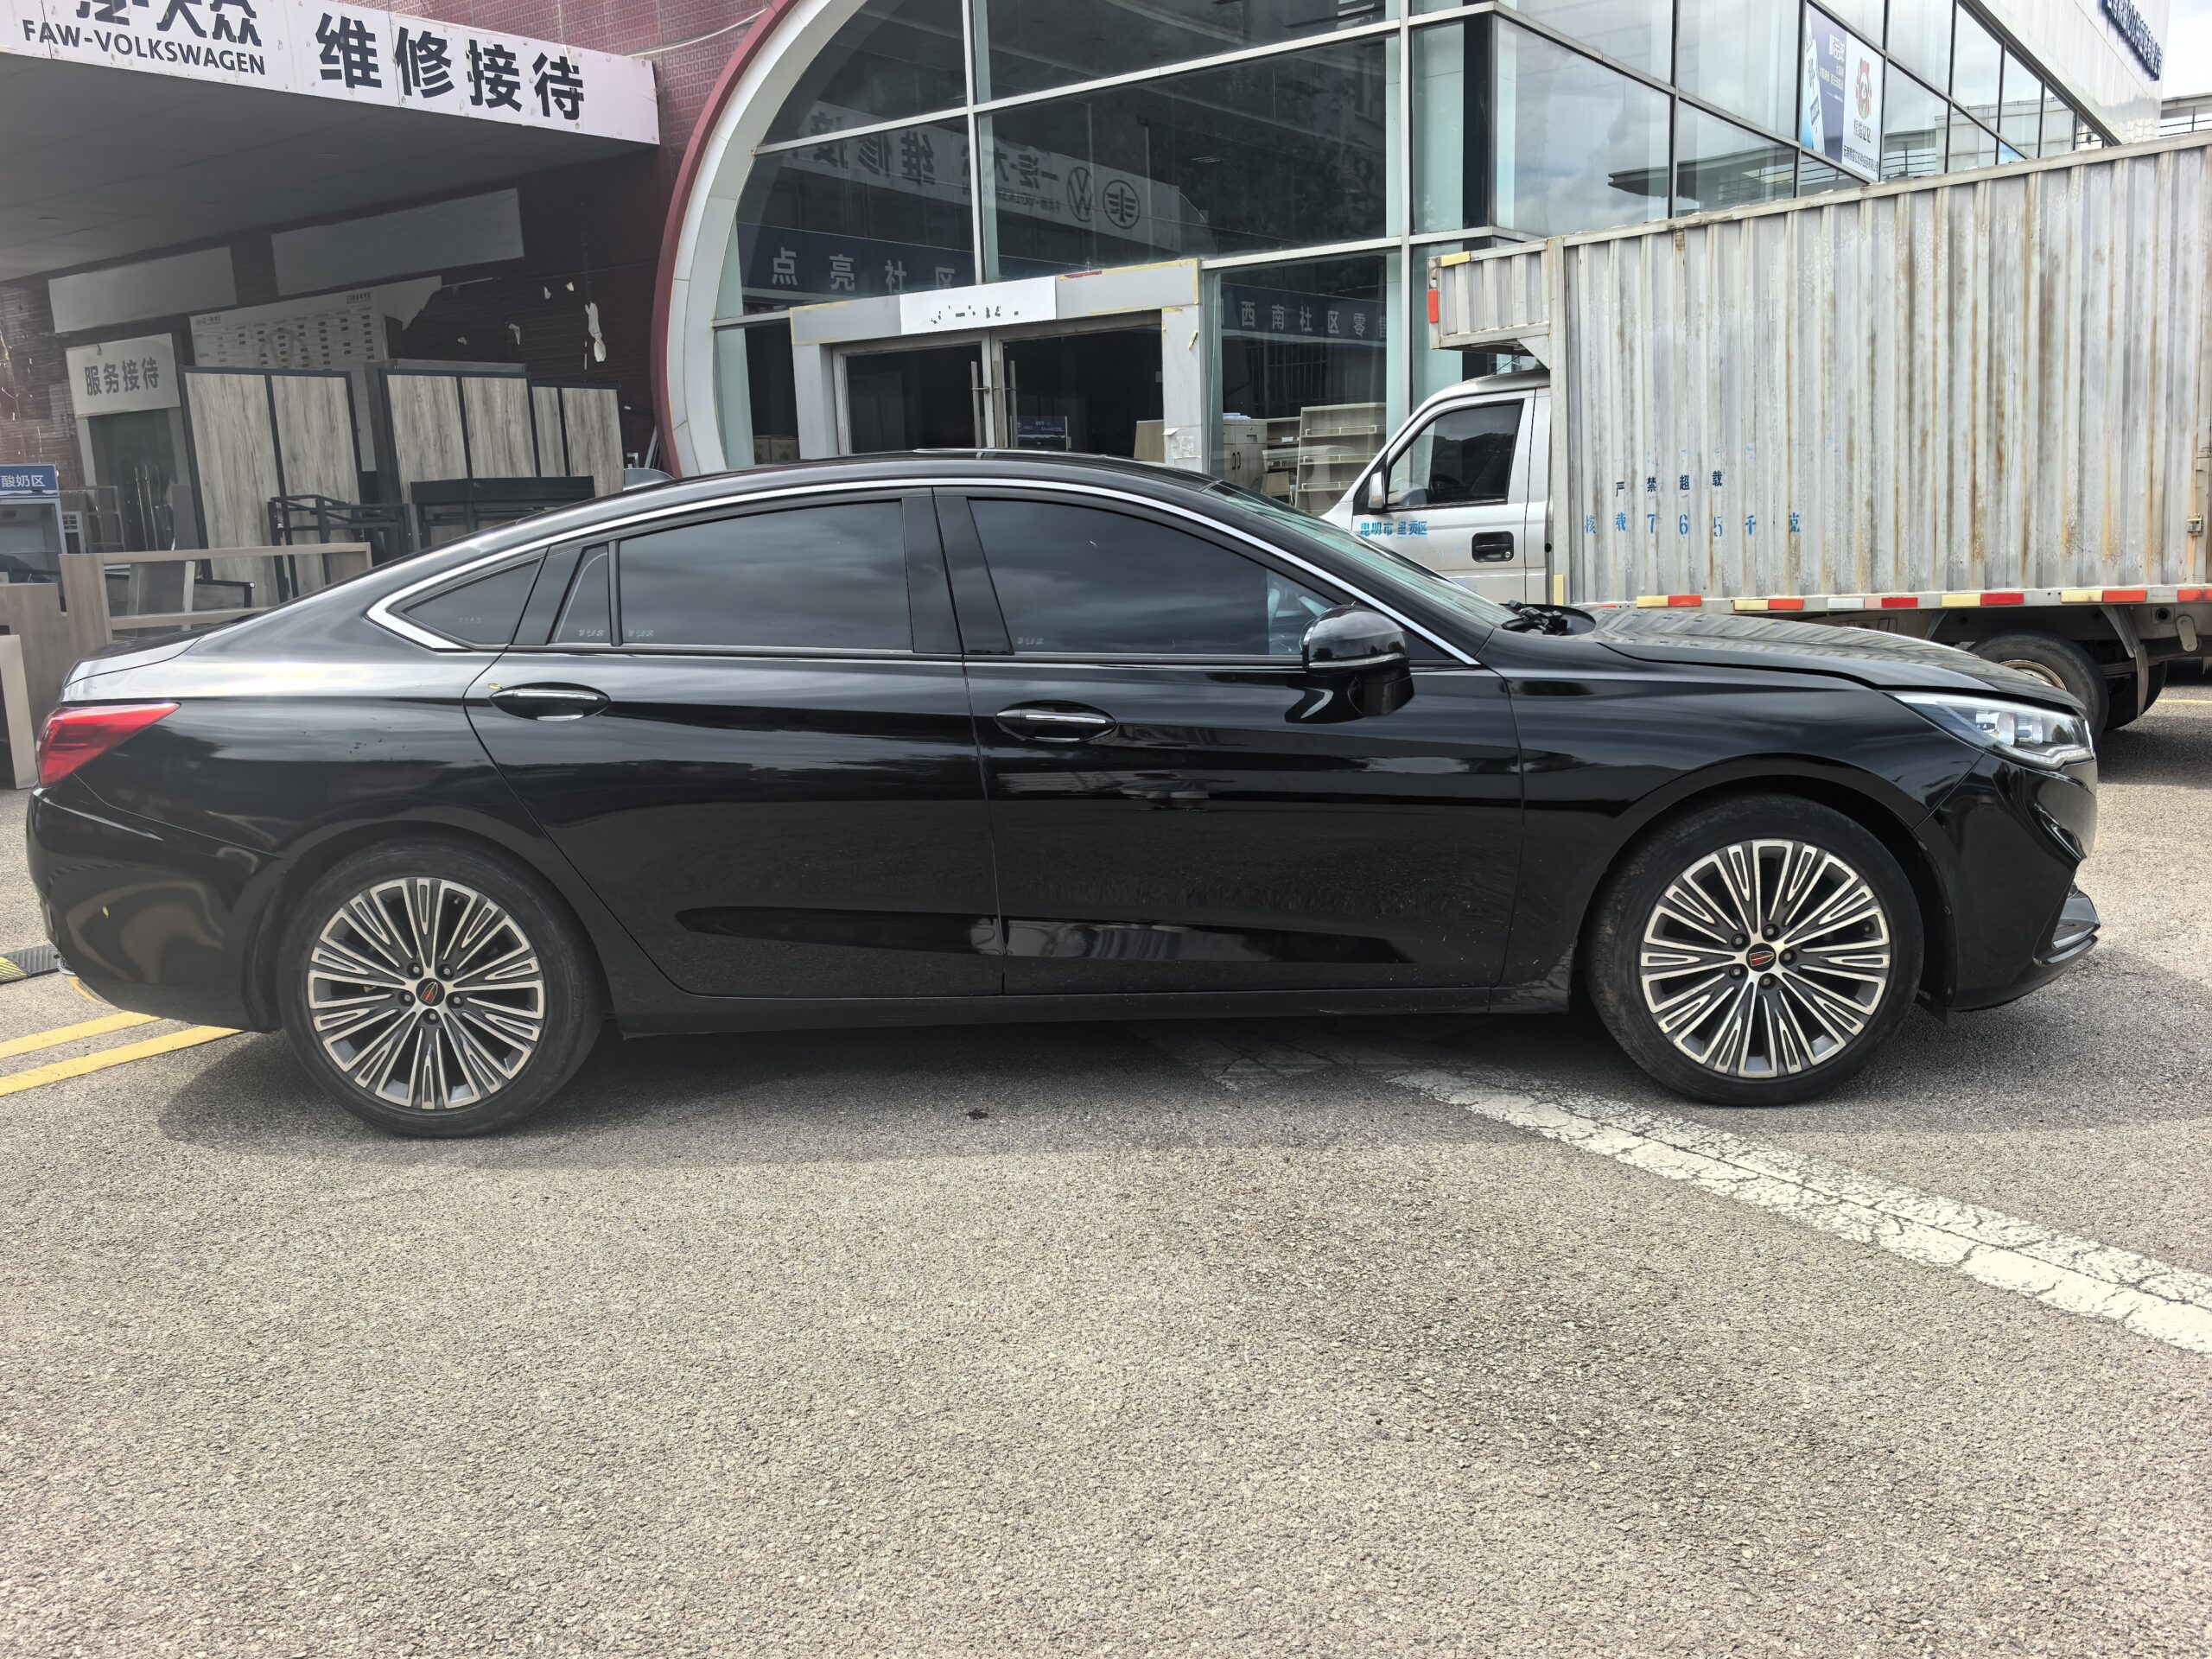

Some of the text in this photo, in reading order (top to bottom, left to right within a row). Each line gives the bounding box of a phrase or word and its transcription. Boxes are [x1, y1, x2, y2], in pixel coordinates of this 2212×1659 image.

[22, 19, 265, 75] FAW-VOLKSWAGEN
[315, 12, 584, 120] 维修接待
[772, 247, 955, 296] 点亮社区
[85, 357, 159, 397] 服务接待
[0, 474, 46, 487] 酸奶区
[1616, 470, 1723, 497] 严禁超载
[1361, 520, 1427, 537] 昆明市呈贡区
[1585, 511, 1801, 537] 核载765千克
